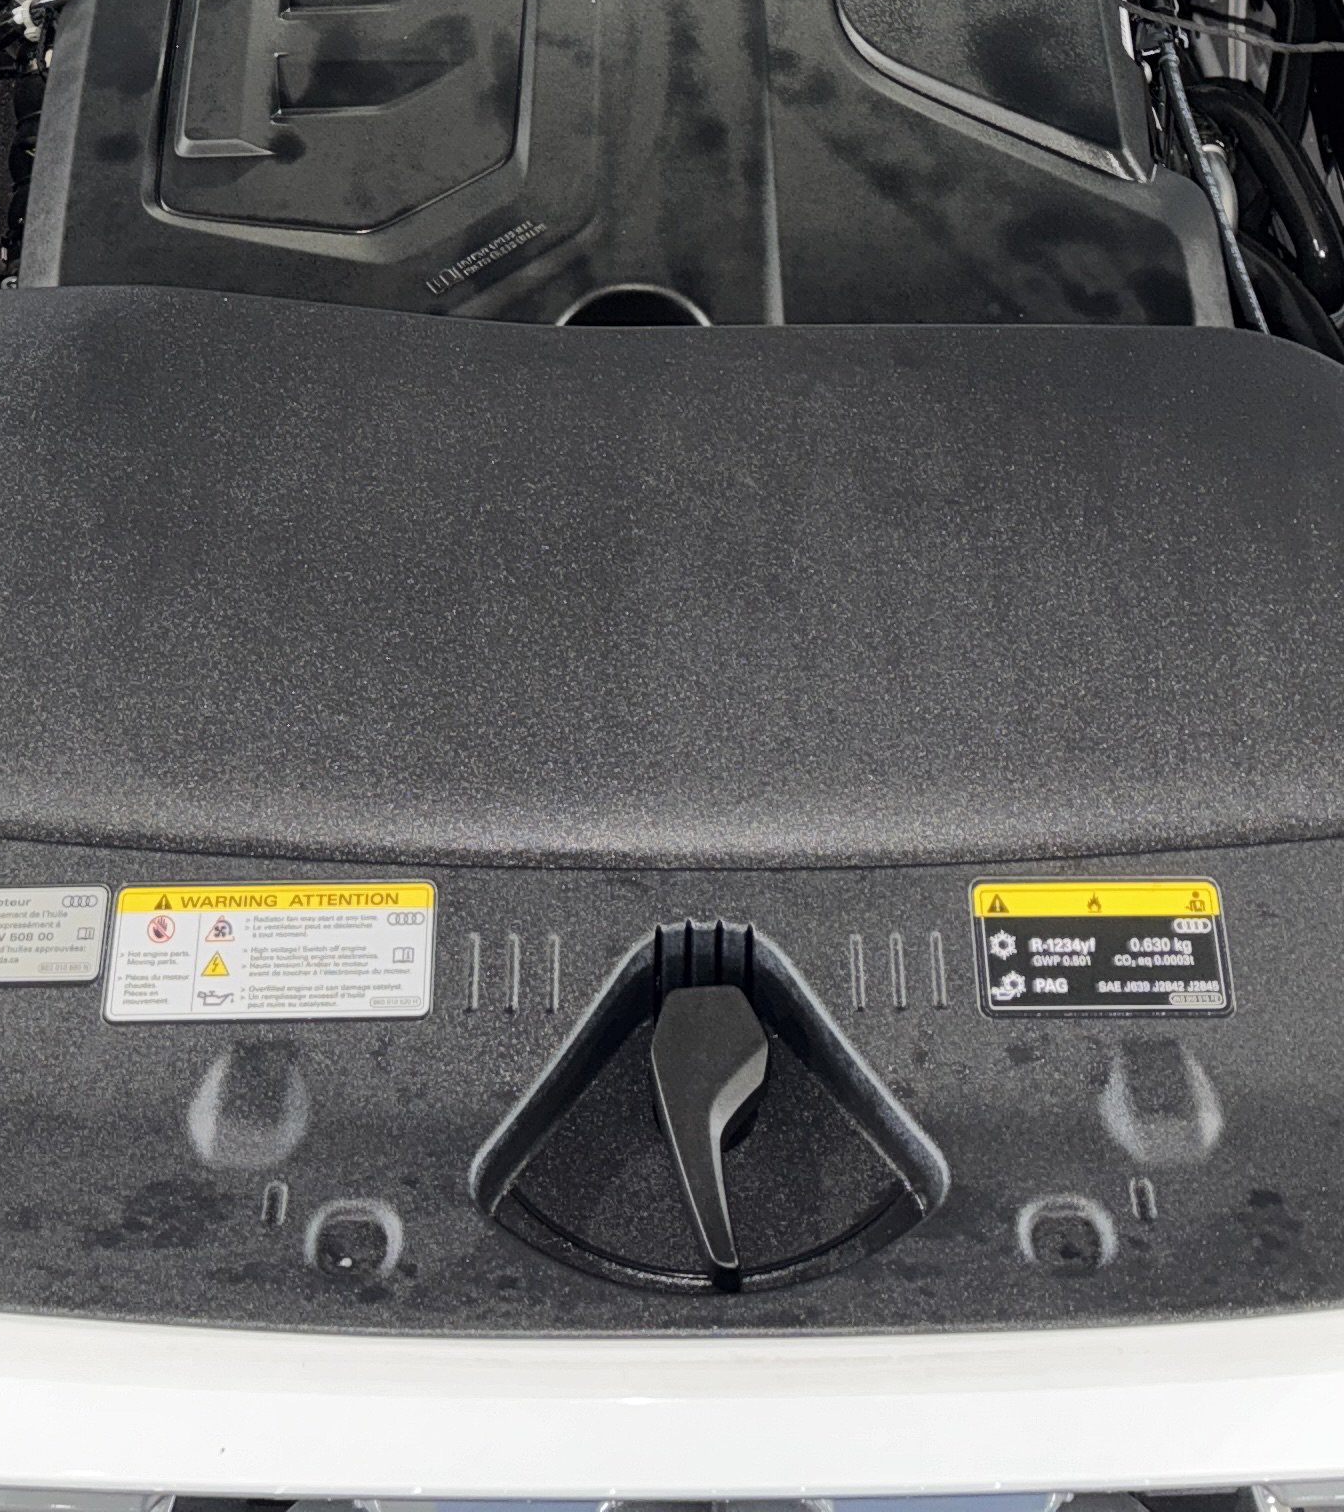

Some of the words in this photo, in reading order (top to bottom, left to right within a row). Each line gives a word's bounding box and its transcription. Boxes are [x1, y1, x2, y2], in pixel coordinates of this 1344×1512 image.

[180, 895, 278, 907] WARNING
[290, 894, 399, 906] ATTENTION
[38, 932, 54, 941] 00
[1030, 938, 1095, 954] R-1234yf
[1129, 938, 1171, 951] 0.630
[1172, 938, 1192, 954] kg
[1033, 956, 1061, 966] GWP
[1137, 957, 1153, 968] eq
[1033, 978, 1068, 992] PAG
[1098, 981, 1121, 992] SAE
[1153, 981, 1184, 992] J2842
